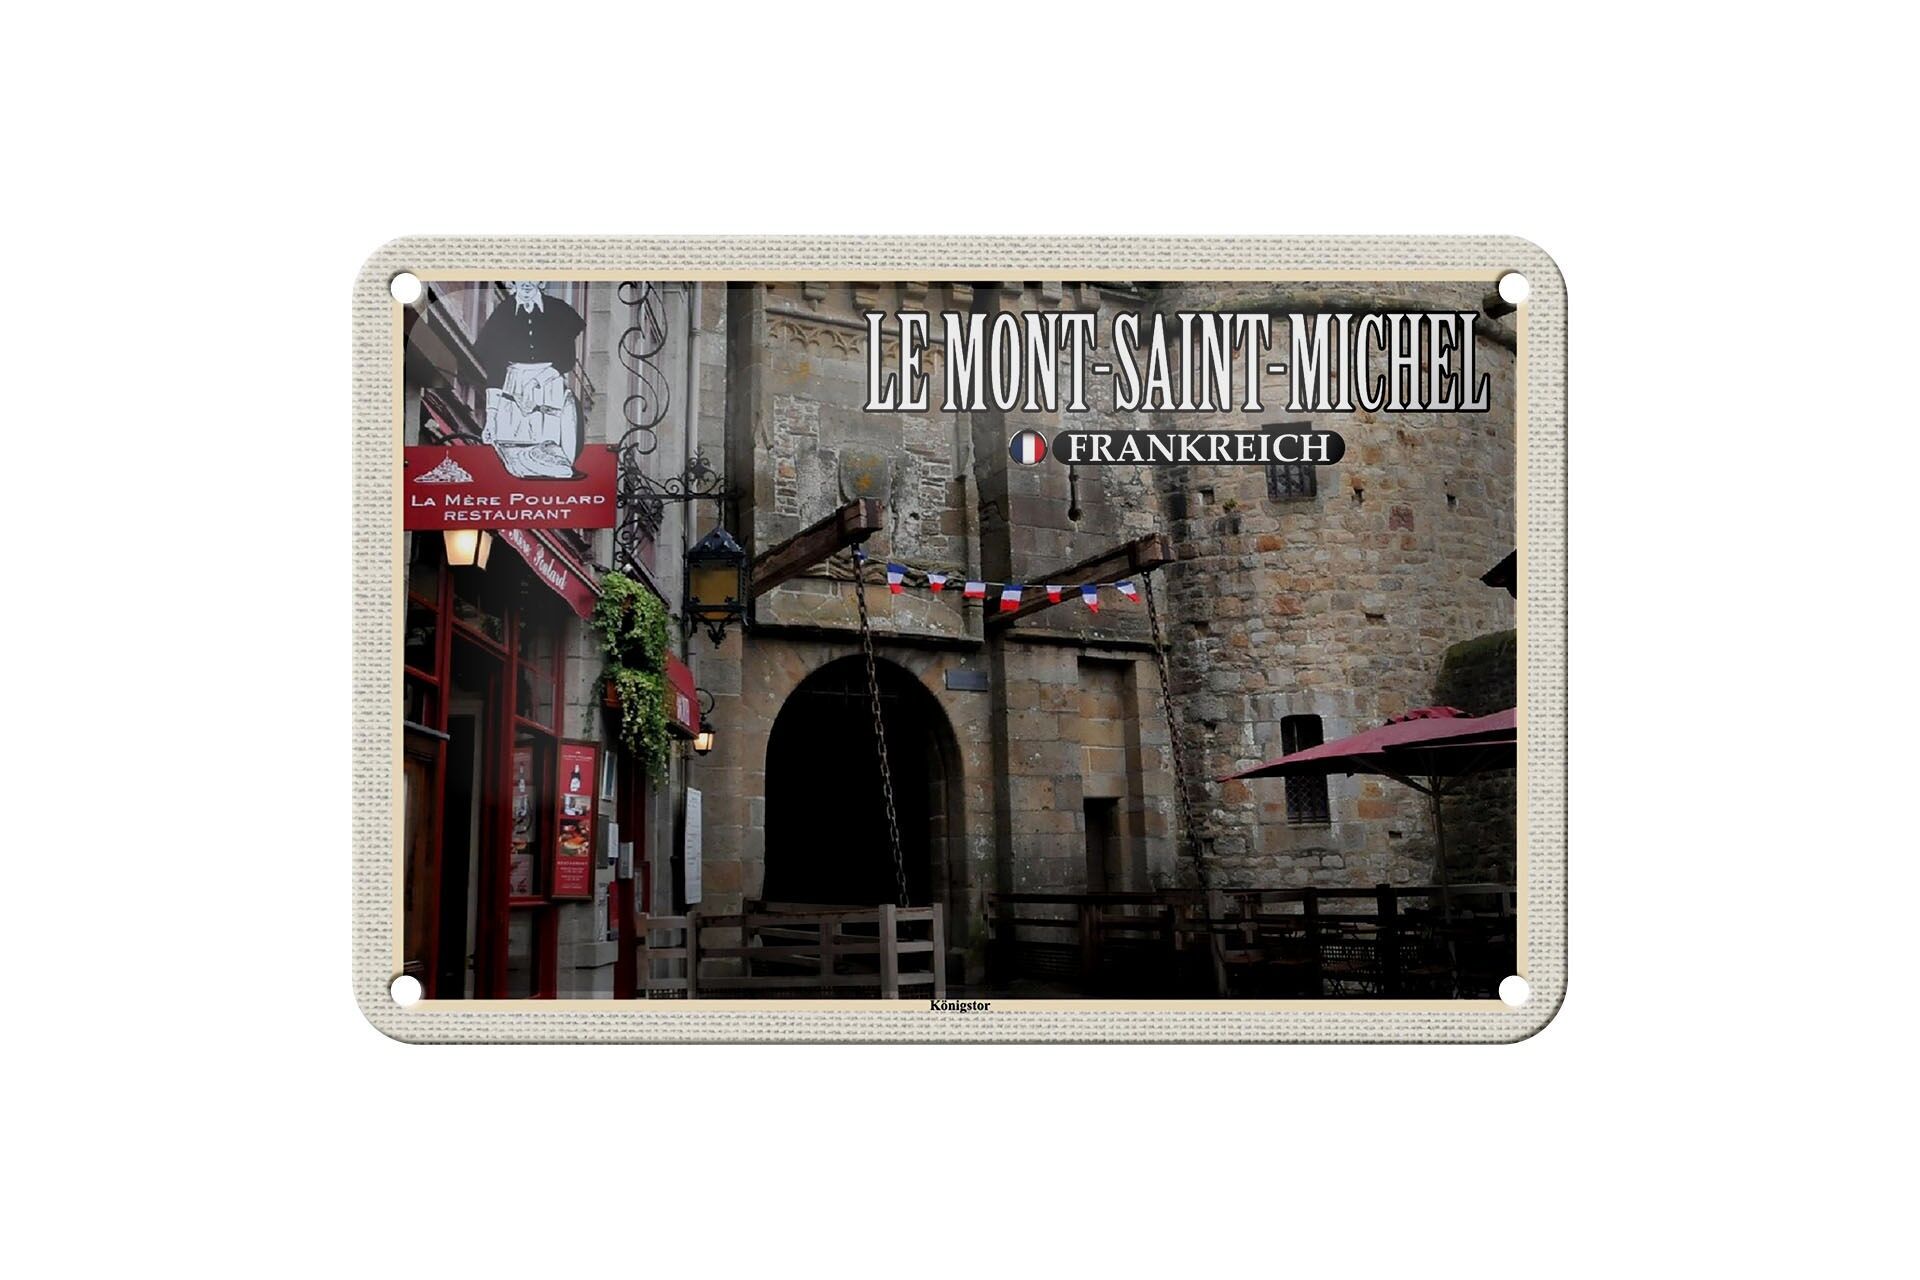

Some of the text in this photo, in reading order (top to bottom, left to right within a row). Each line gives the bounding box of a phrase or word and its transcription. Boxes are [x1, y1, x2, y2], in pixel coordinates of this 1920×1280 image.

[865, 312, 1490, 411] LE MONT-SAINT-MICHEL
[1066, 433, 1331, 463] FRANKREICH
[509, 493, 606, 506] POULARD
[443, 509, 571, 521] RESTAURANT
[930, 999, 991, 1013] Königstor
